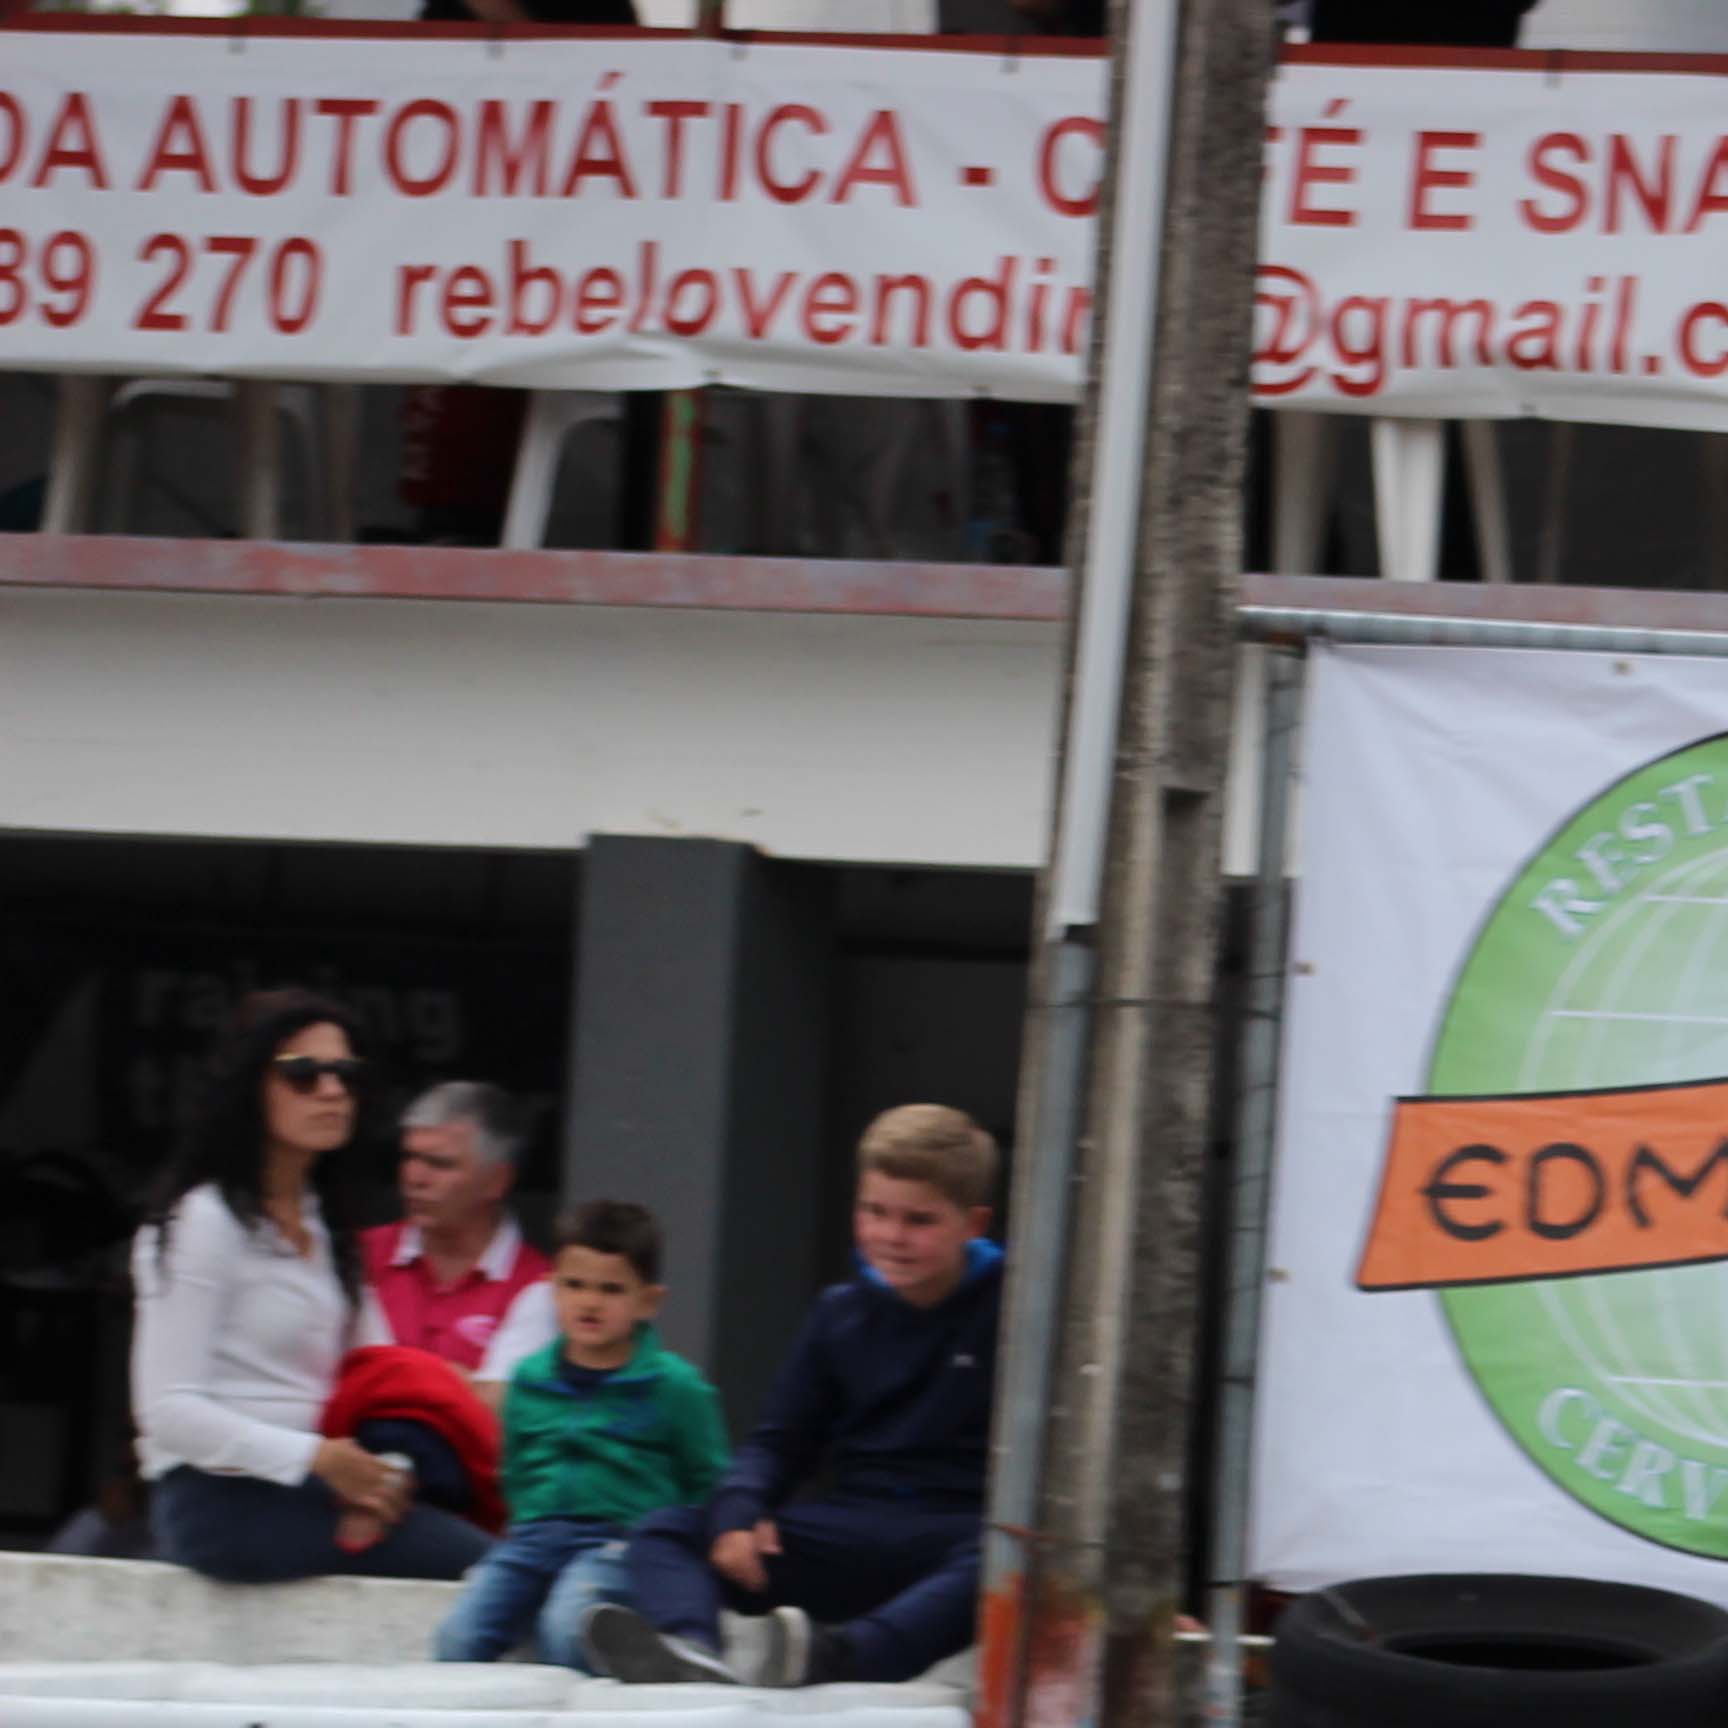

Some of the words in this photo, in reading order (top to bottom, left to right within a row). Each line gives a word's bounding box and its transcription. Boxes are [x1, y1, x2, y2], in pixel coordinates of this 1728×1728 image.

[137, 70, 918, 208] AUTOMÁTICA
[1408, 130, 1482, 232] E
[134, 234, 324, 336] 270
